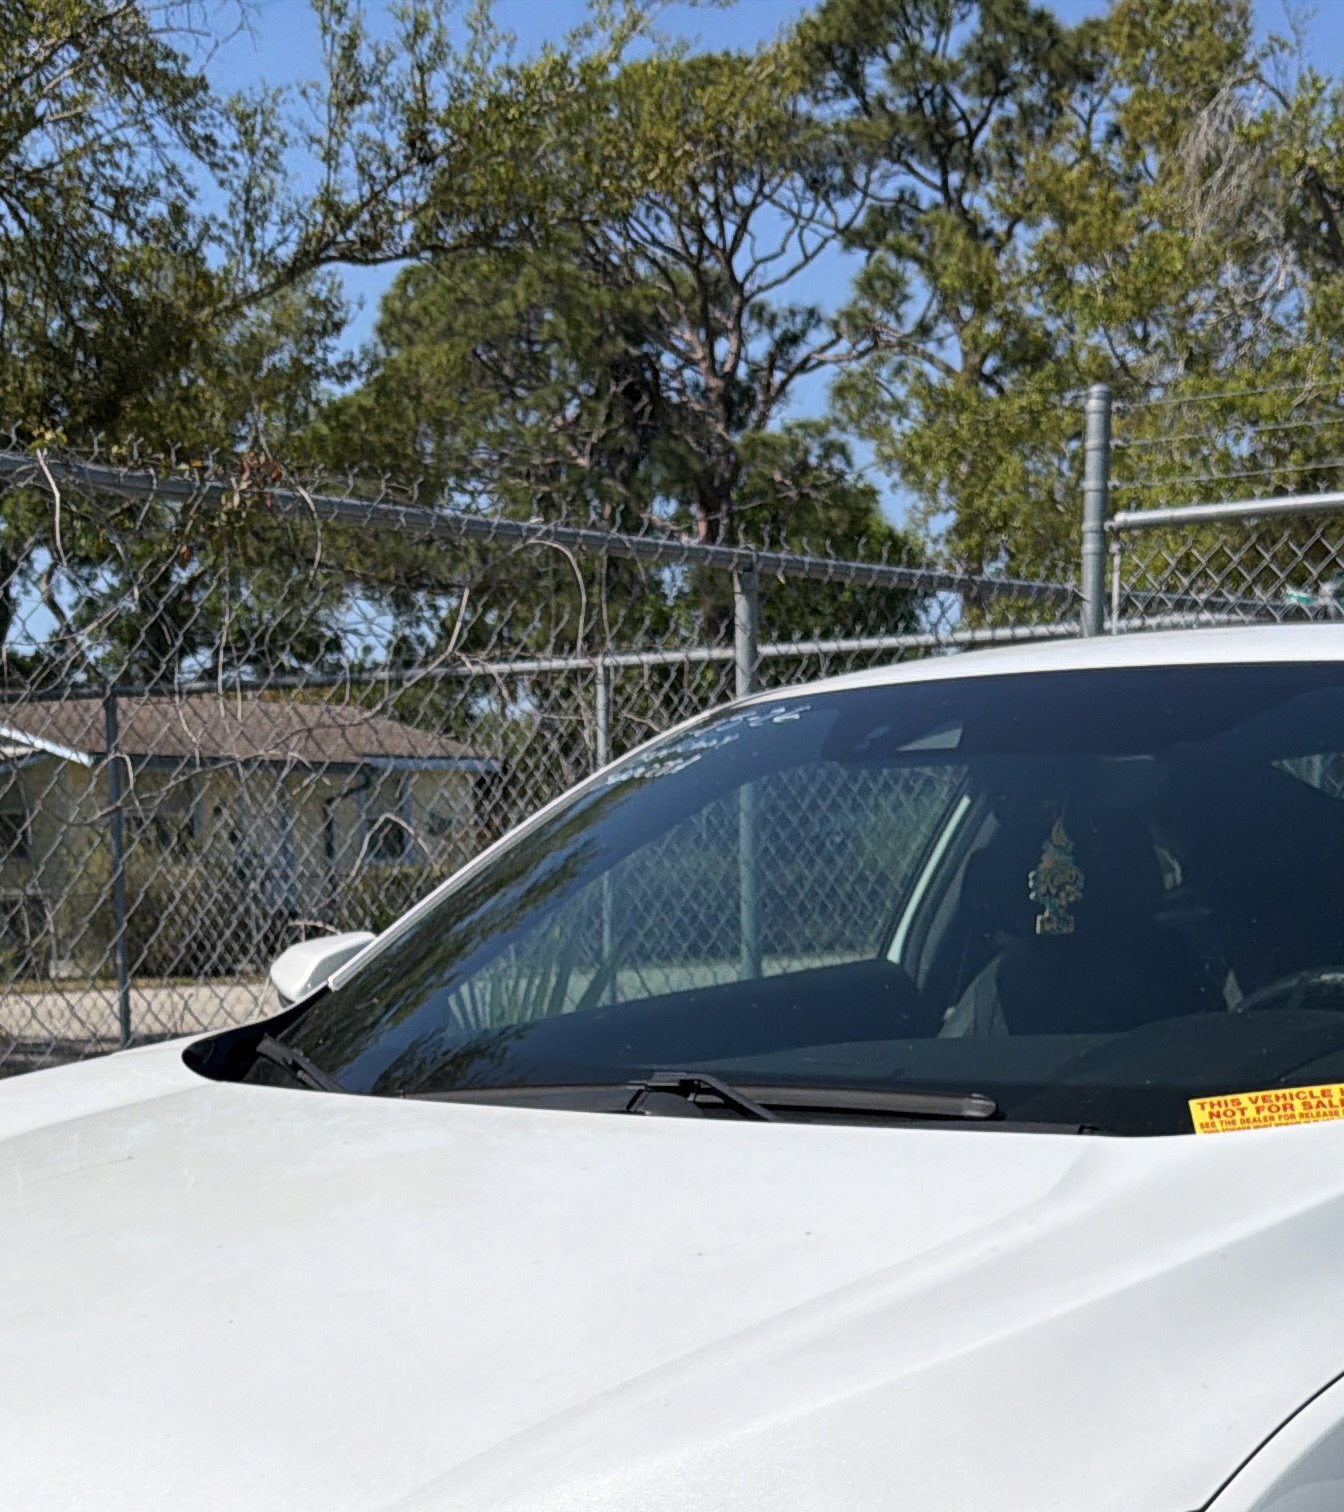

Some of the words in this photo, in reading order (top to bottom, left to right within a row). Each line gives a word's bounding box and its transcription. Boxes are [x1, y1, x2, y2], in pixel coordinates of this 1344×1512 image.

[1197, 1098, 1242, 1111] THIS
[1248, 1089, 1333, 1105] VEHICLE
[1199, 1120, 1216, 1130] SEE
[1219, 1117, 1237, 1128] THE
[1240, 1115, 1275, 1126] DEALER
[1278, 1112, 1297, 1121] FOR
[1299, 1109, 1340, 1120] RELEASE
[1208, 1107, 1249, 1120] NOT
[1255, 1103, 1295, 1115] FOR
